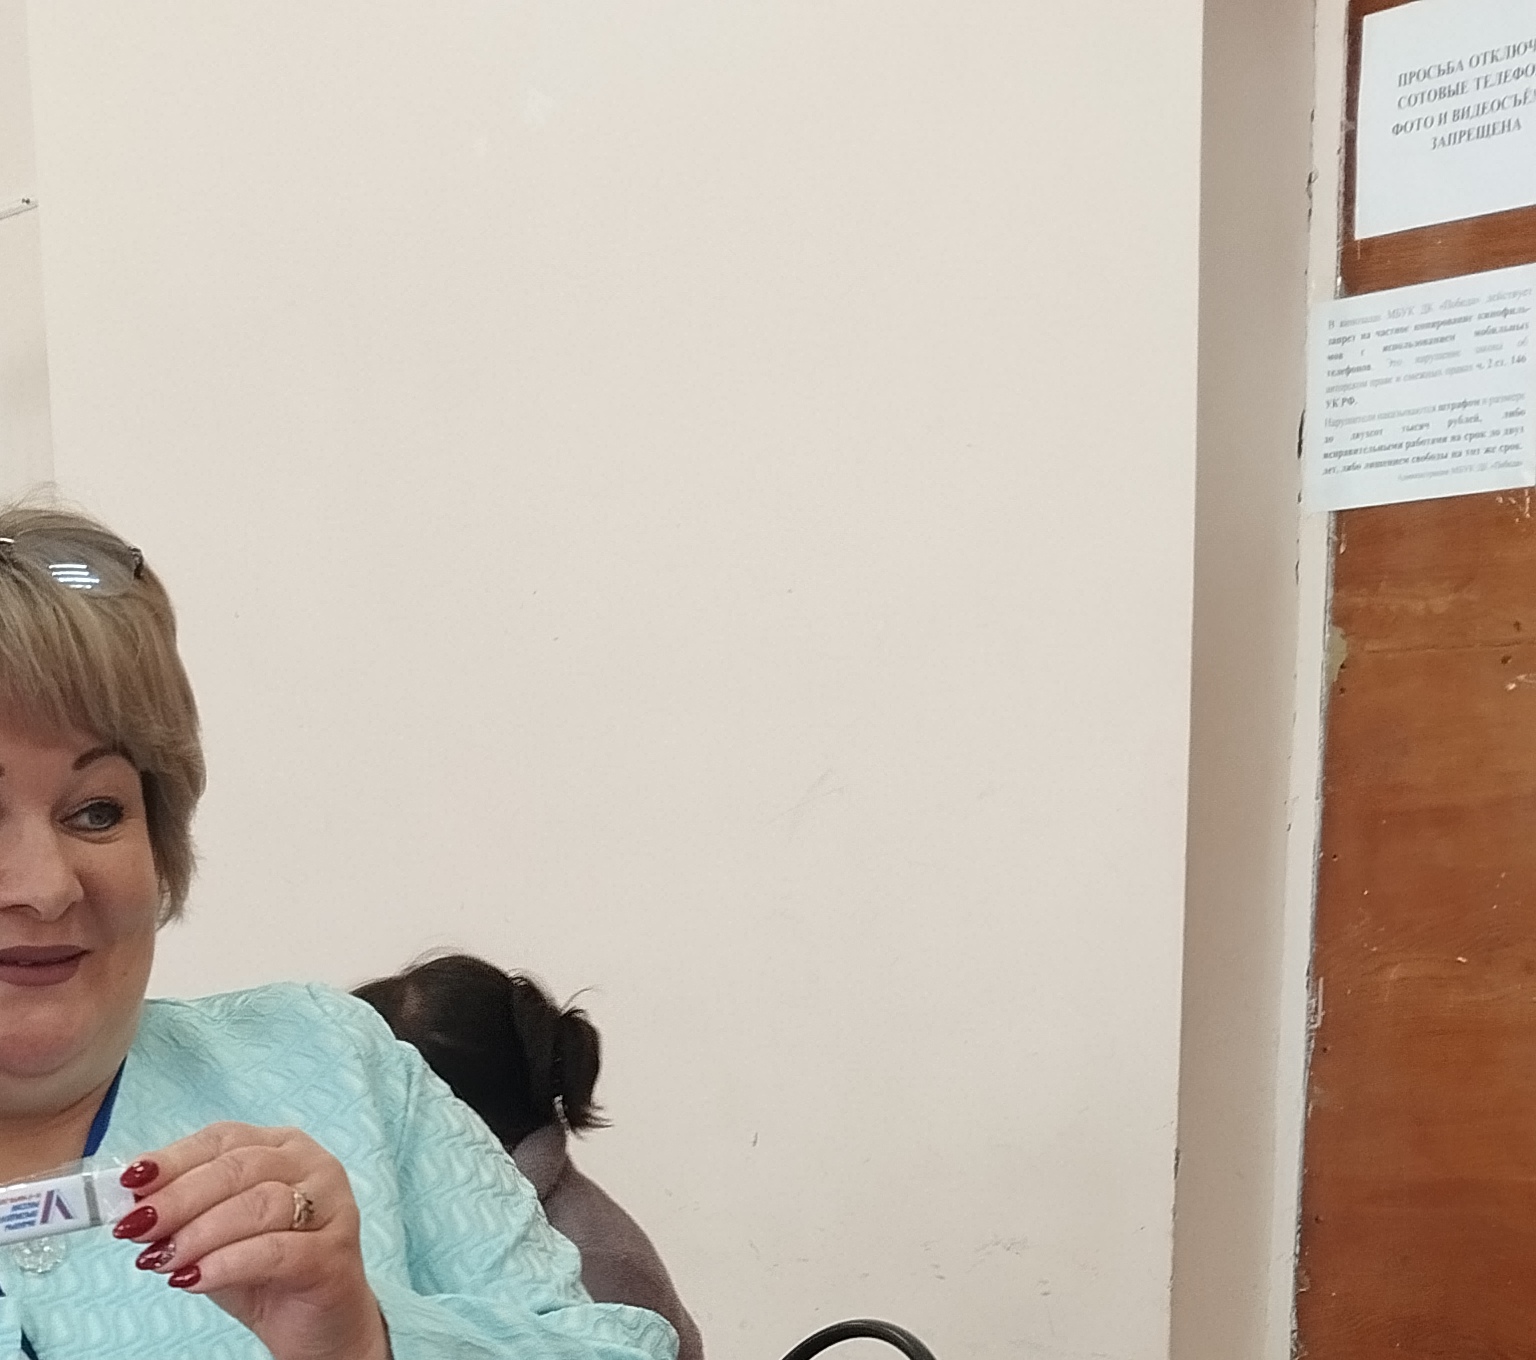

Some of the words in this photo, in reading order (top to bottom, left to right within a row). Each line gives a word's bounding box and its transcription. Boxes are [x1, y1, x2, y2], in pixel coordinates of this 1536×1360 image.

[1397, 58, 1464, 88] ПРОСЬБА
[1397, 80, 1469, 110] СОТОВЫЕ
[1391, 115, 1434, 137] ФОТО
[1437, 111, 1449, 127] И
[1452, 89, 1536, 123] ВИДЕОСЪЁ
[1430, 117, 1523, 151] ЗАПРЕЩЕНА
